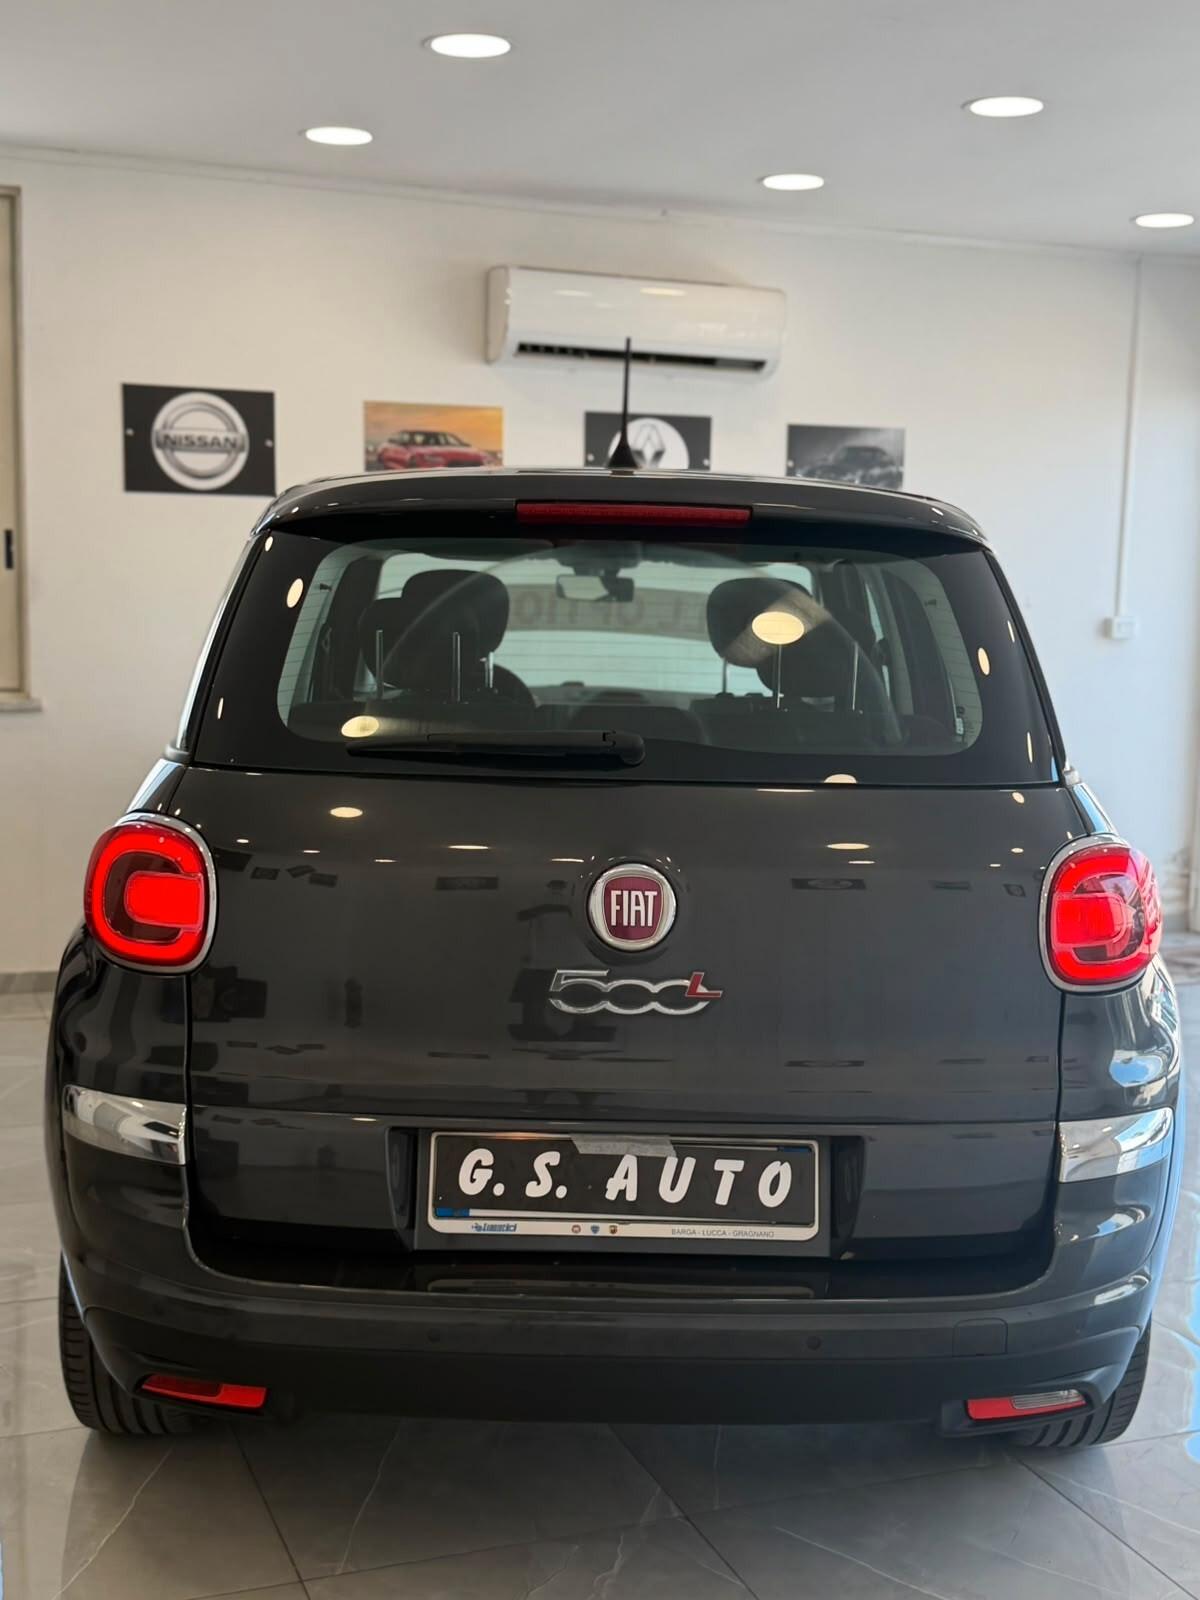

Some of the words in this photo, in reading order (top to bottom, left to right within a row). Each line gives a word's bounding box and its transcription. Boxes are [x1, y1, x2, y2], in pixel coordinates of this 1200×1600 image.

[163, 434, 237, 449] NISSAN
[611, 890, 657, 927] FIAT
[549, 969, 723, 1015] 500L
[458, 1148, 505, 1196] G.
[525, 1151, 567, 1199] S.
[605, 1154, 792, 1208] AUTO
[671, 1228, 697, 1236] BARGA
[702, 1229, 727, 1237] LUCCA
[732, 1230, 775, 1238] GRAGNANO
